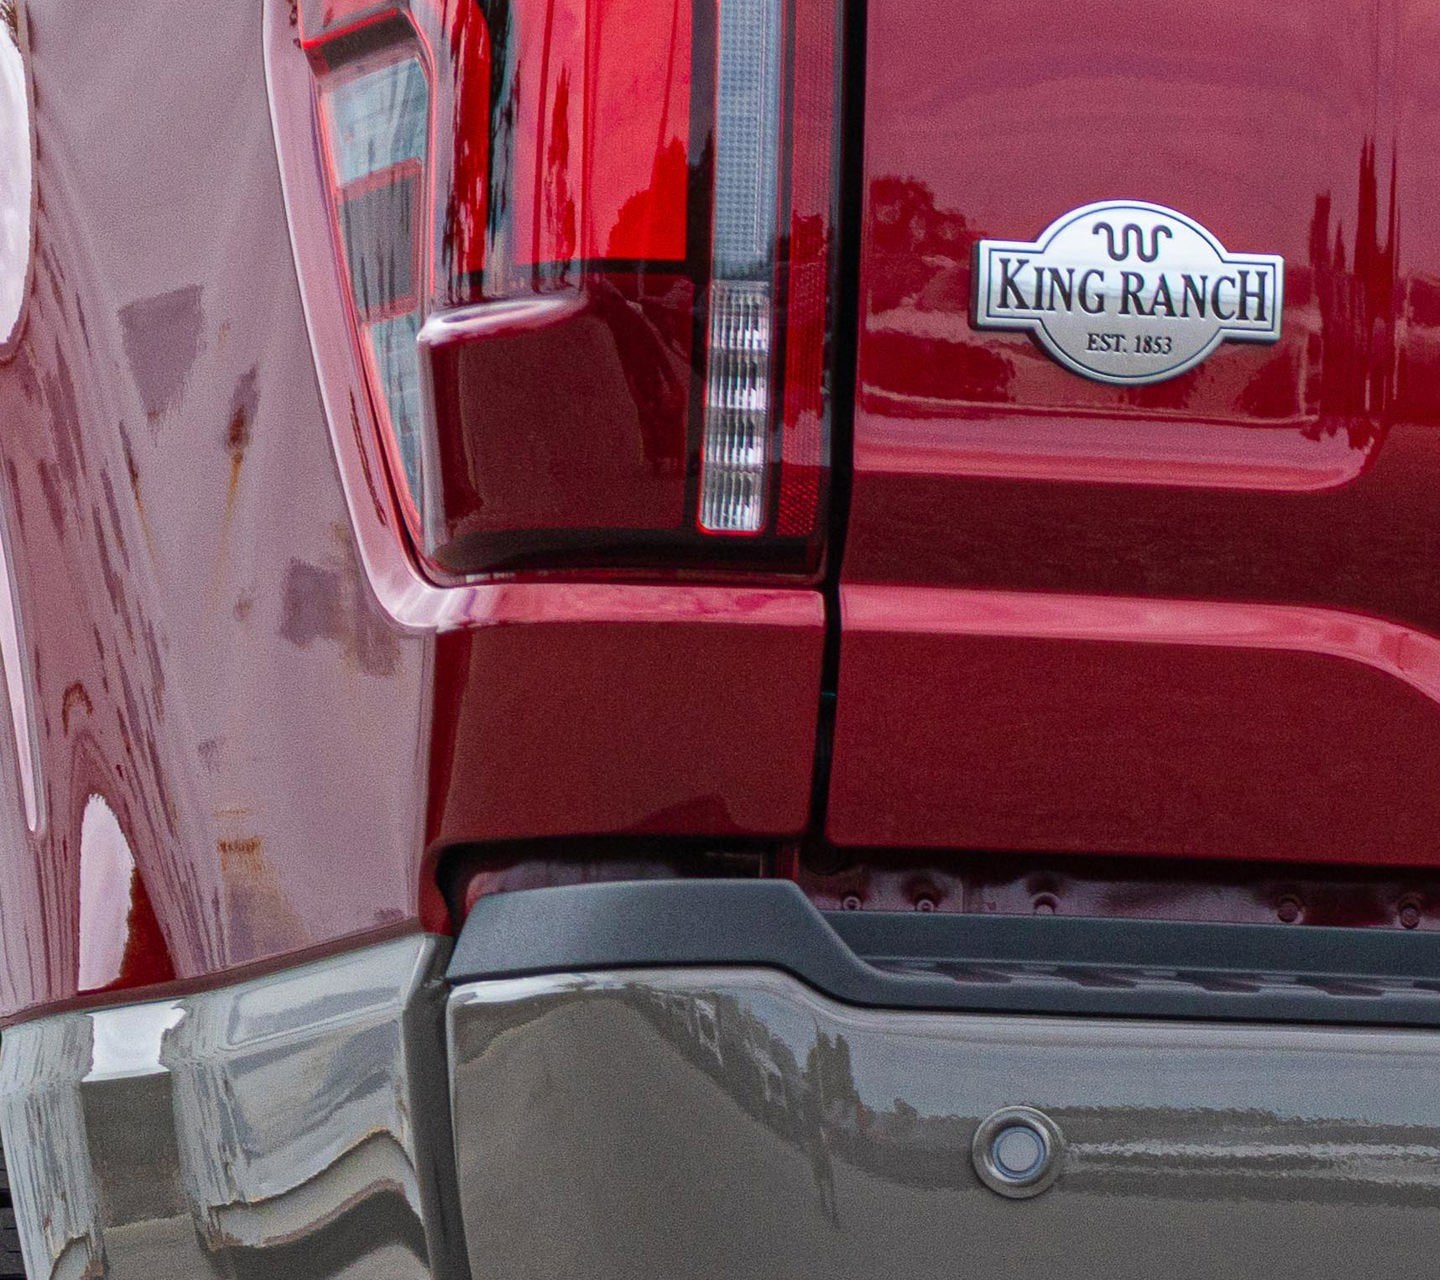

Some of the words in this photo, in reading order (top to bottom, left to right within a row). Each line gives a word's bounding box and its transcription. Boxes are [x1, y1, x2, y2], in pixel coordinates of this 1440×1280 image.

[996, 258, 1105, 315] KING
[1118, 270, 1268, 322] RANCH
[1087, 332, 1128, 354] EST.
[1134, 336, 1172, 356] 1853
